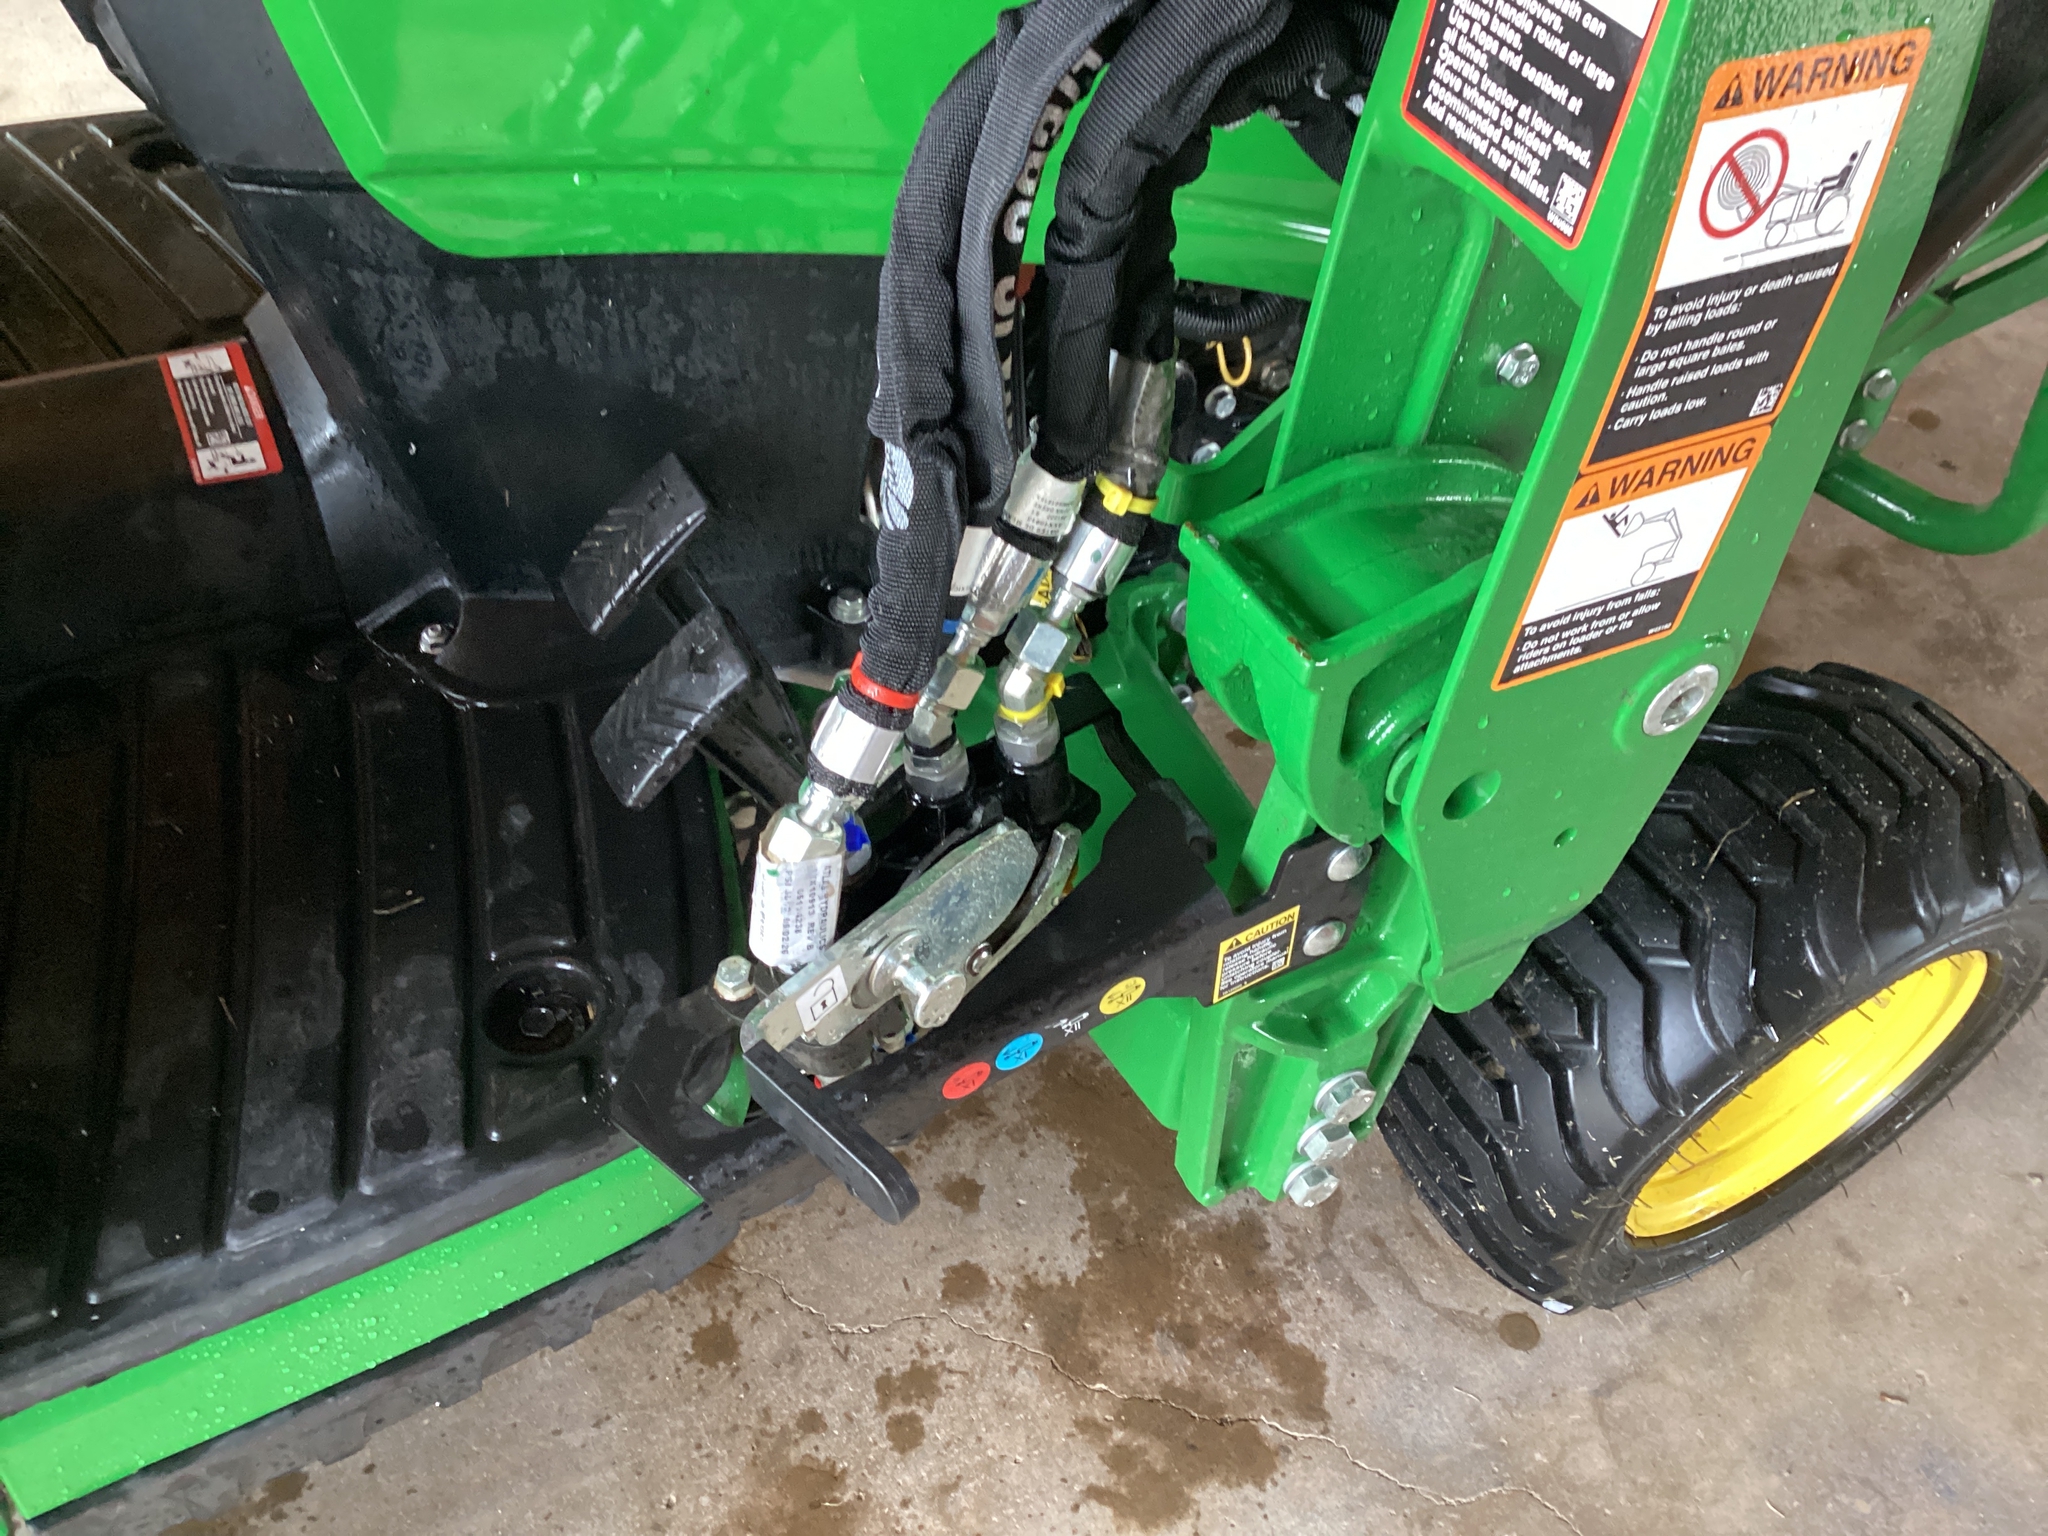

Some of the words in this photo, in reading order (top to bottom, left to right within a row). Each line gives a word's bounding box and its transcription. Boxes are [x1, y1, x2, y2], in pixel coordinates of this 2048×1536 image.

[1489, 13, 1523, 51] bales.
[1547, 0, 1582, 23] eath
[1582, 12, 1607, 39] can
[1443, 27, 1458, 46] all
[1457, 34, 1489, 71] times.
[1449, 5, 1470, 29] Use
[1470, 21, 1499, 55] Rops
[1499, 46, 1523, 71] and
[1521, 62, 1569, 105] seatbelt
[1567, 96, 1583, 116] at
[1533, 25, 1570, 59] round
[1568, 50, 1585, 69] or
[1582, 56, 1615, 92] large
[1753, 39, 1917, 104] WARNING
[1428, 79, 1503, 142] recommended
[1501, 135, 1542, 176] setting.
[1433, 58, 1462, 92] Move
[1463, 83, 1500, 121] wheels
[1500, 111, 1513, 130] to
[1513, 122, 1551, 161] widest
[1438, 42, 1481, 84] Operate
[1480, 73, 1519, 112] tractor
[1517, 104, 1532, 123] at
[1531, 110, 1553, 137] low
[1552, 130, 1591, 170] speed.
[1422, 95, 1445, 121] Add
[1444, 113, 1489, 155] required
[1488, 146, 1512, 172] rear
[1510, 161, 1550, 204] ballast.
[1653, 306, 1668, 321] To
[1669, 295, 1704, 317] avoid
[1706, 288, 1743, 308] injury
[1744, 283, 1758, 298] or
[1759, 276, 1793, 295] death
[1794, 262, 1839, 285] caused
[1639, 349, 1657, 364] Do
[1660, 342, 1683, 359] not
[1684, 332, 1726, 353] handle
[1726, 322, 1763, 341] round
[1763, 318, 1778, 330] or
[1645, 322, 1664, 337] by
[1663, 311, 1703, 332] falling
[1704, 302, 1743, 323] loads:
[1625, 377, 1669, 400] Handle
[1670, 366, 1709, 387] raised
[1709, 357, 1744, 378] loads
[1745, 350, 1770, 366] with
[1634, 360, 1666, 379] large
[1667, 350, 1711, 369] square
[1711, 339, 1746, 359] bales.
[1613, 414, 1647, 431] Carry
[1648, 403, 1682, 422] loads
[1683, 396, 1707, 412] low.
[1620, 391, 1668, 414] caution.
[1609, 437, 1757, 500] WARNING
[1522, 639, 1539, 652] Do
[1540, 633, 1559, 646] not
[1561, 623, 1588, 639] work
[1589, 617, 1616, 633] from
[1618, 611, 1630, 621] or
[1631, 601, 1662, 618] allow
[1524, 625, 1537, 637] To
[1538, 613, 1571, 632] avoid
[1572, 605, 1605, 622] injury
[1605, 596, 1632, 612] from
[1633, 588, 1661, 603] falls:
[1512, 646, 1582, 675] attachments.
[1517, 646, 1550, 664] riders
[1552, 642, 1567, 652] on
[1568, 631, 1603, 647] loader
[1604, 625, 1617, 635] or
[1618, 620, 1633, 631] its
[1245, 912, 1295, 942] CAUTION
